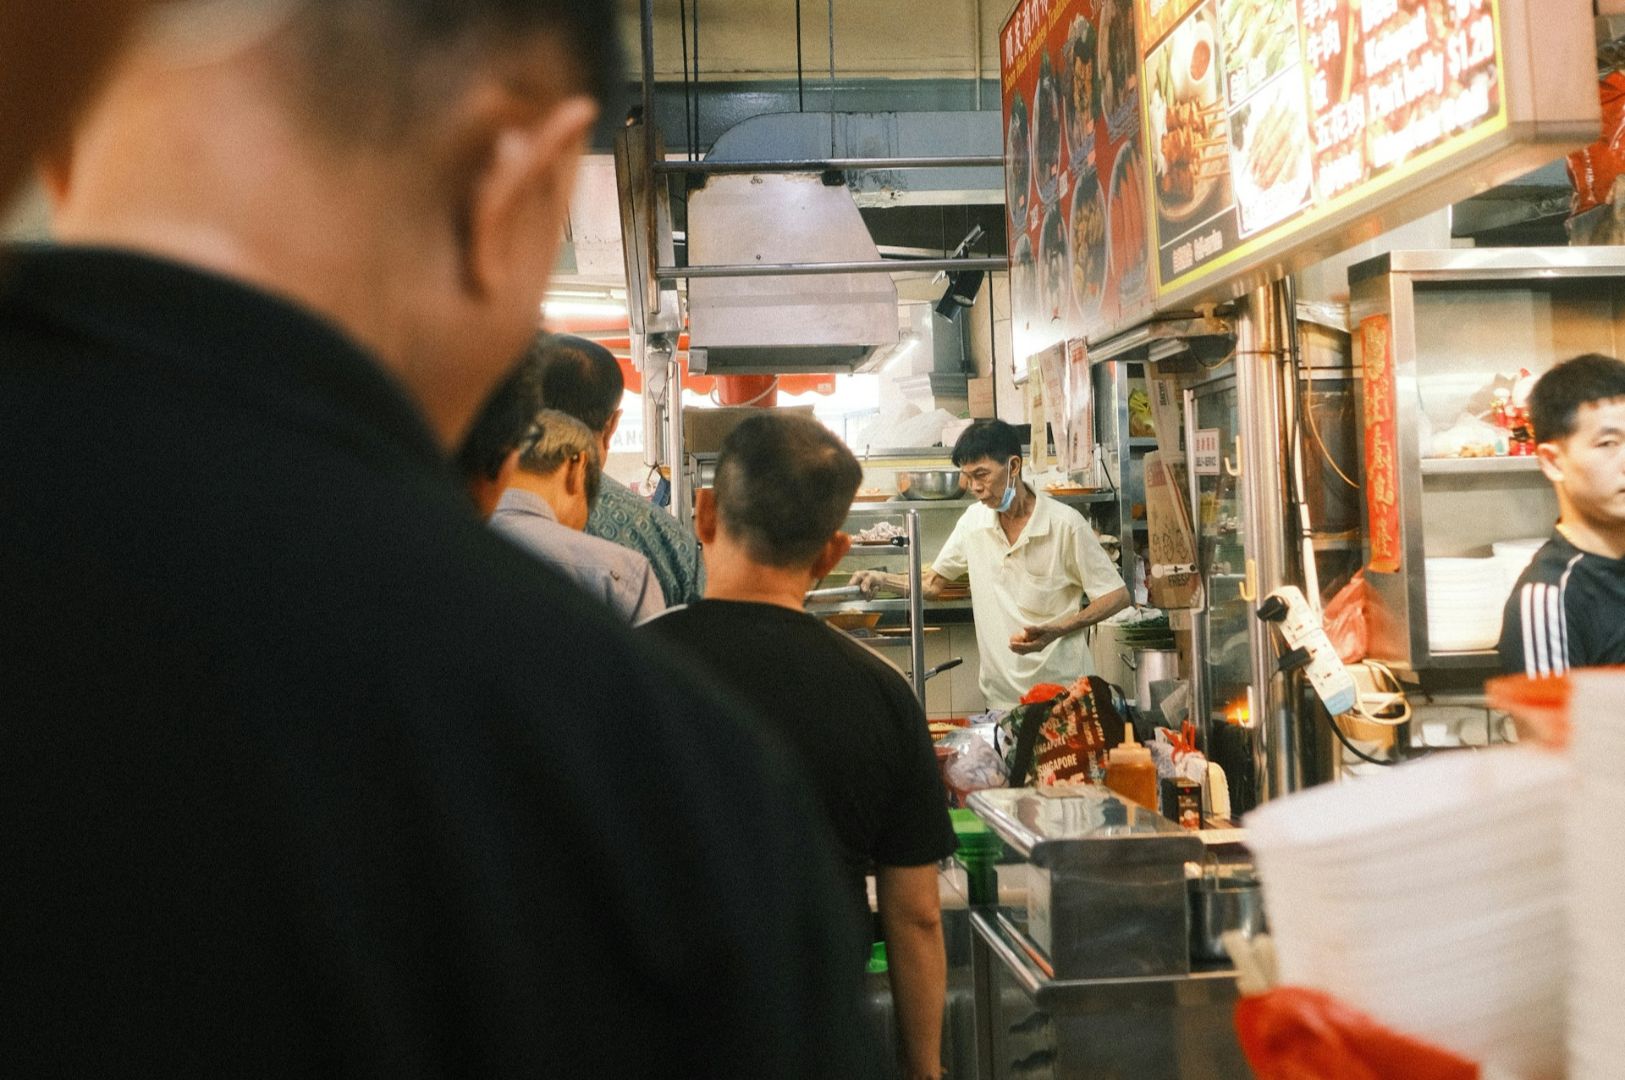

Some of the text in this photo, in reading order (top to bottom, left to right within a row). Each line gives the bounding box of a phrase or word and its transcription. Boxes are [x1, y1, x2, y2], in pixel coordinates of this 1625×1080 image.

[1313, 94, 1366, 151] 五花肉
[1037, 753, 1078, 777] SINGAPORE
